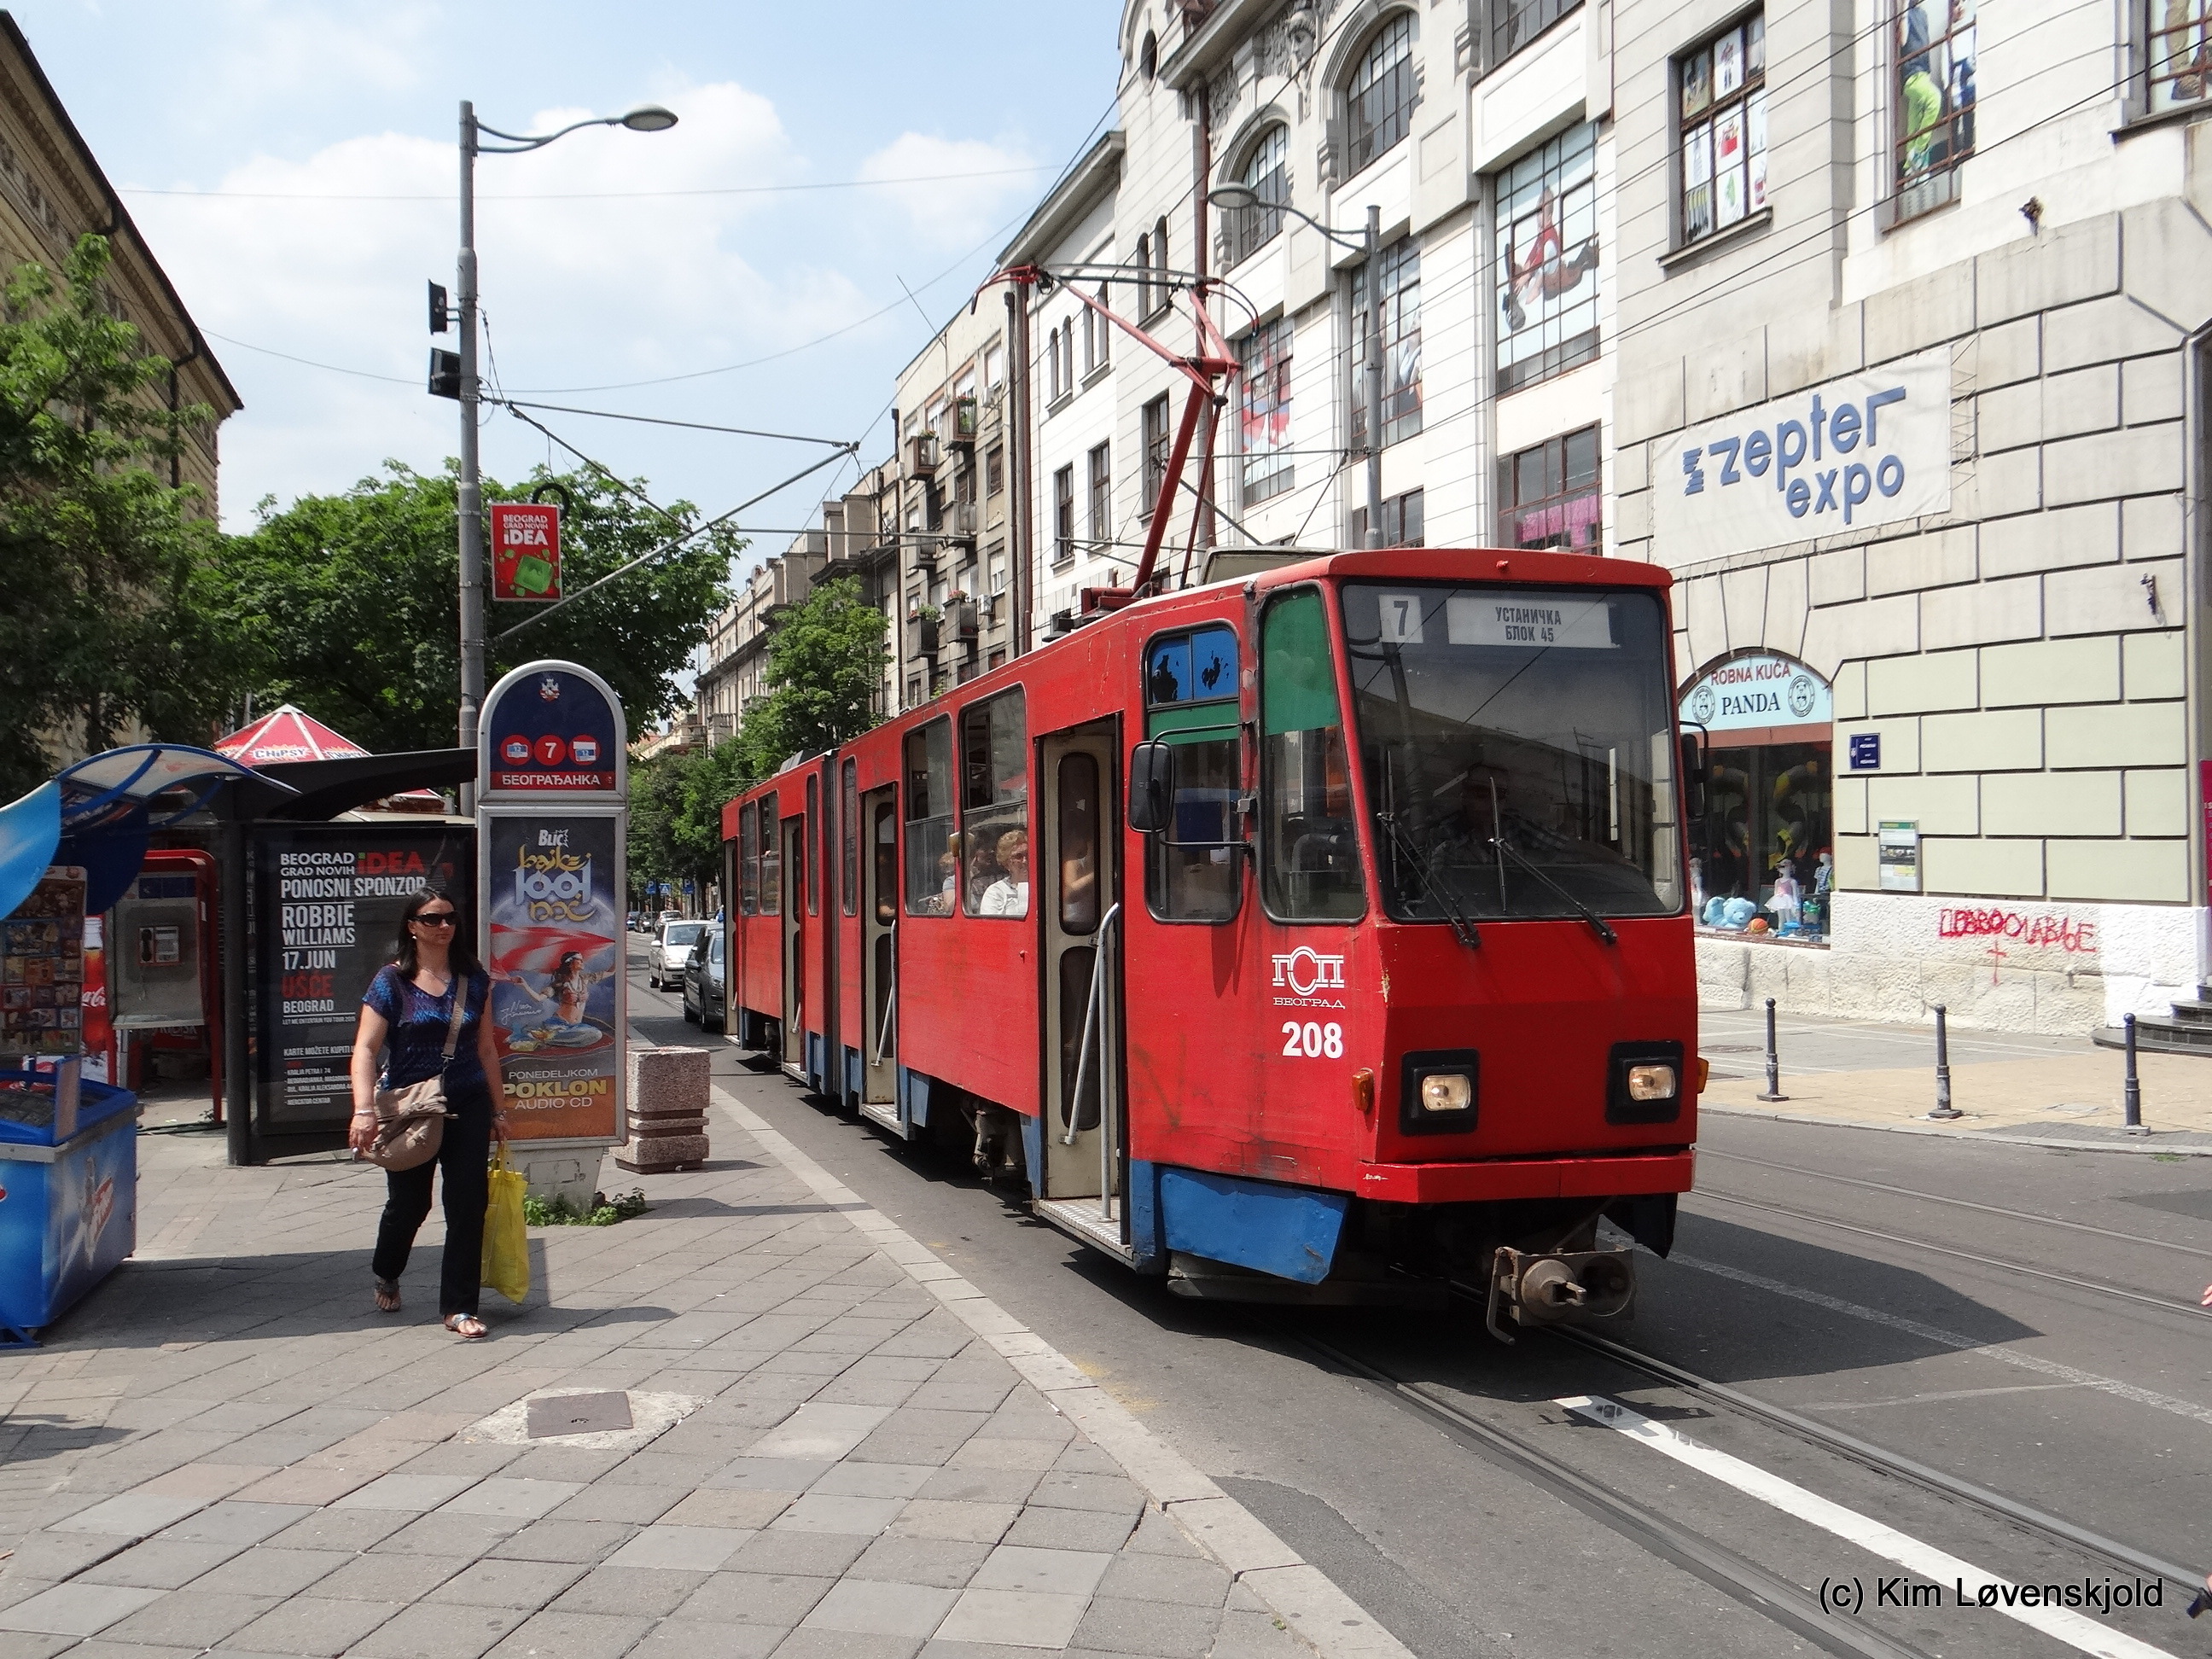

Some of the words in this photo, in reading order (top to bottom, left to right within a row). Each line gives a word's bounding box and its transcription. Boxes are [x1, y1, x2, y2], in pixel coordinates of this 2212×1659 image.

[1708, 386, 1906, 492] zepter
[1786, 454, 1905, 525] expo
[503, 514, 548, 523] BEOGRAD
[1393, 601, 1409, 636] 7
[1495, 606, 1562, 626] УСТАНИЧКА
[1505, 625, 1535, 642] БЛОК
[1540, 627, 1555, 643] 45
[1711, 666, 1753, 686] ROBNA
[1721, 691, 1781, 715] PANDA
[544, 742, 557, 759] 7
[502, 775, 601, 785] БЕОГРАЂАНКА
[280, 853, 355, 865] BEOGRAD
[280, 866, 314, 876] GRAD
[316, 865, 355, 876] NOVIH
[281, 878, 351, 899] PONOSNI
[282, 905, 355, 928] ROBBIE
[282, 927, 356, 946] WILLIAMS
[282, 950, 336, 970] 17.JUN
[1272, 946, 1345, 997] ГСП
[282, 999, 335, 1014] BEOGRAD
[1281, 1021, 1343, 1059] 208
[283, 1048, 305, 1057] KARTE
[305, 1045, 329, 1056] MOŽETE
[330, 1045, 350, 1054] KUPITI
[509, 1068, 598, 1080] PONEDELJKOM
[502, 1080, 607, 1098] POKLON
[515, 1097, 565, 1109] AUDIO
[569, 1097, 592, 1108] CD
